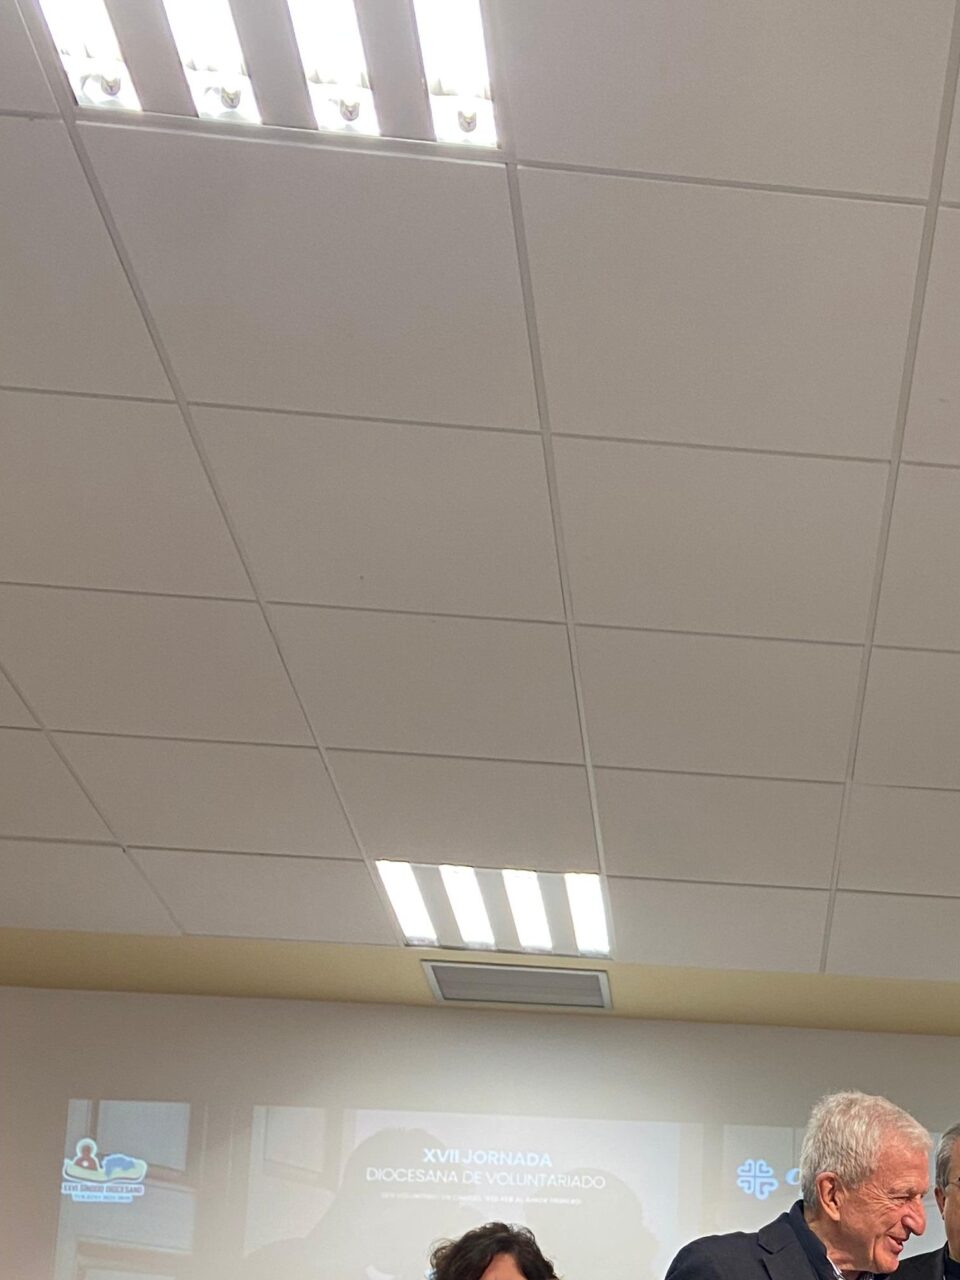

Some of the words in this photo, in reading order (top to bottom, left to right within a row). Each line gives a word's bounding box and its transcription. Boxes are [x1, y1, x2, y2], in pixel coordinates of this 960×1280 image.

[423, 1148, 460, 1164] XVII
[463, 1150, 553, 1167] JORNADA
[366, 1167, 458, 1183] DIOCESANA
[462, 1170, 483, 1184] DE
[485, 1171, 606, 1189] VOLUNTARIADO
